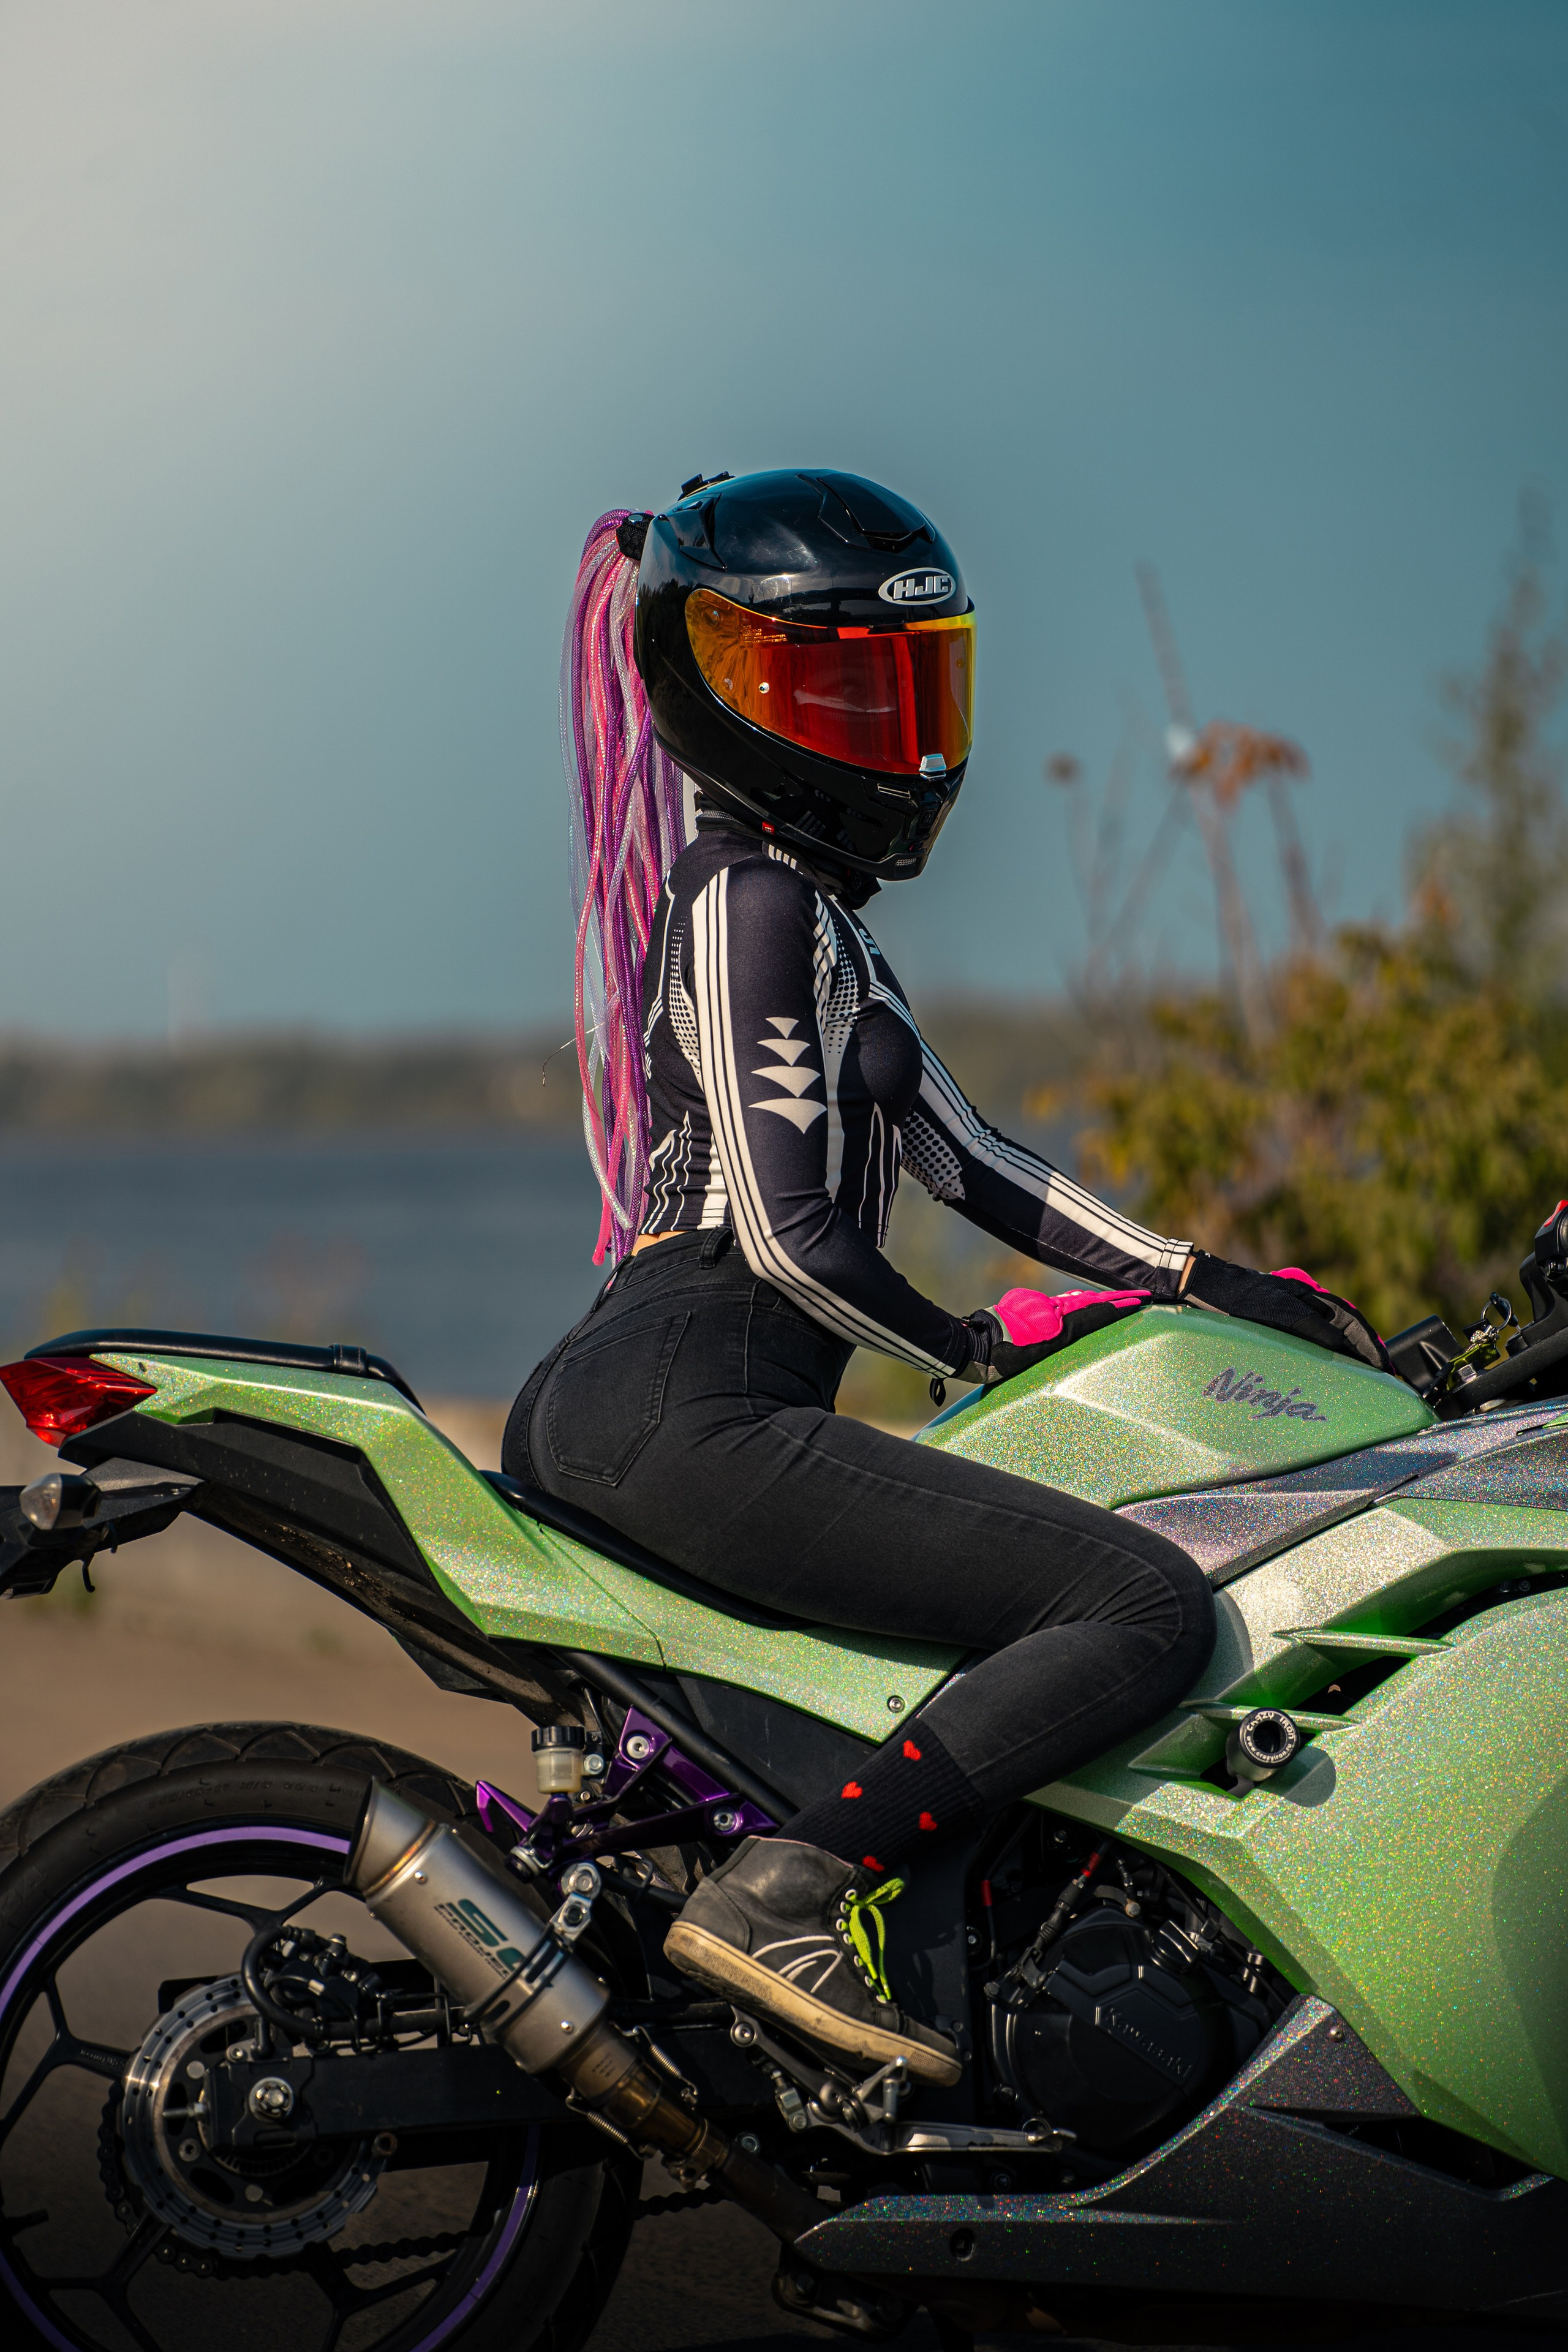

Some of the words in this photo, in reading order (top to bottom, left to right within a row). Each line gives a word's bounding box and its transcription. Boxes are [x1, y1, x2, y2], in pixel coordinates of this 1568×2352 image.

[894, 575, 949, 600] HJC
[1202, 1366, 1327, 1422] Ninja
[1104, 2006, 1192, 2078] Kawasaki
